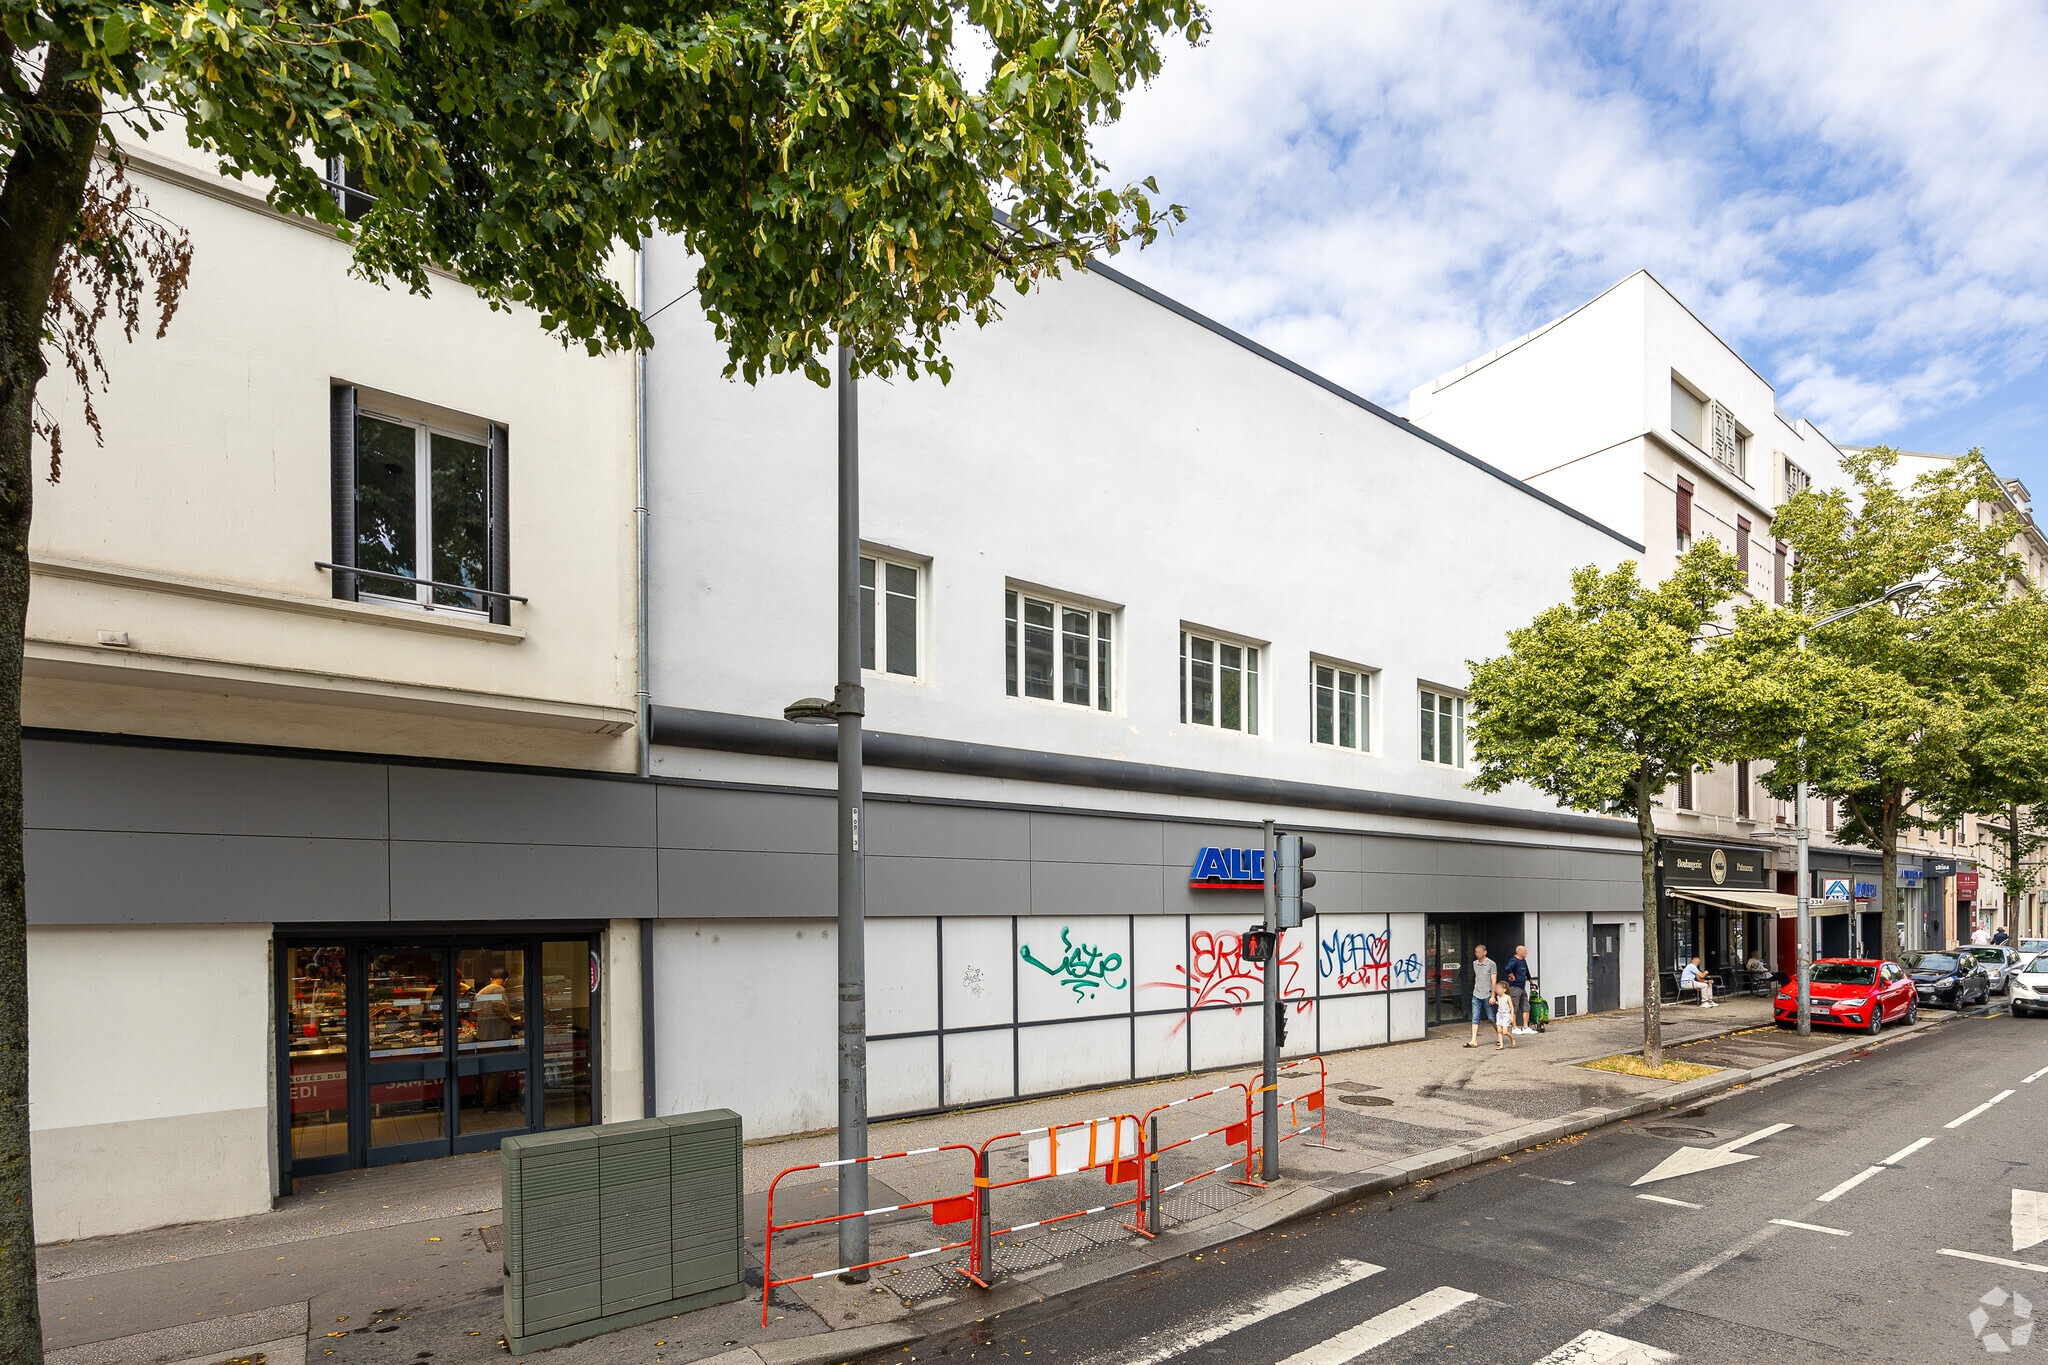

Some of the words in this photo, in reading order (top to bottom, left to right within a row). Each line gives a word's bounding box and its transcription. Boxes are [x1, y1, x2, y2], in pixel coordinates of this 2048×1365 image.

[1190, 847, 1277, 880] ALD
[1856, 883, 1877, 898] ALDI
[289, 1074, 323, 1083] AUTÉS
[289, 1085, 318, 1100] EDI
